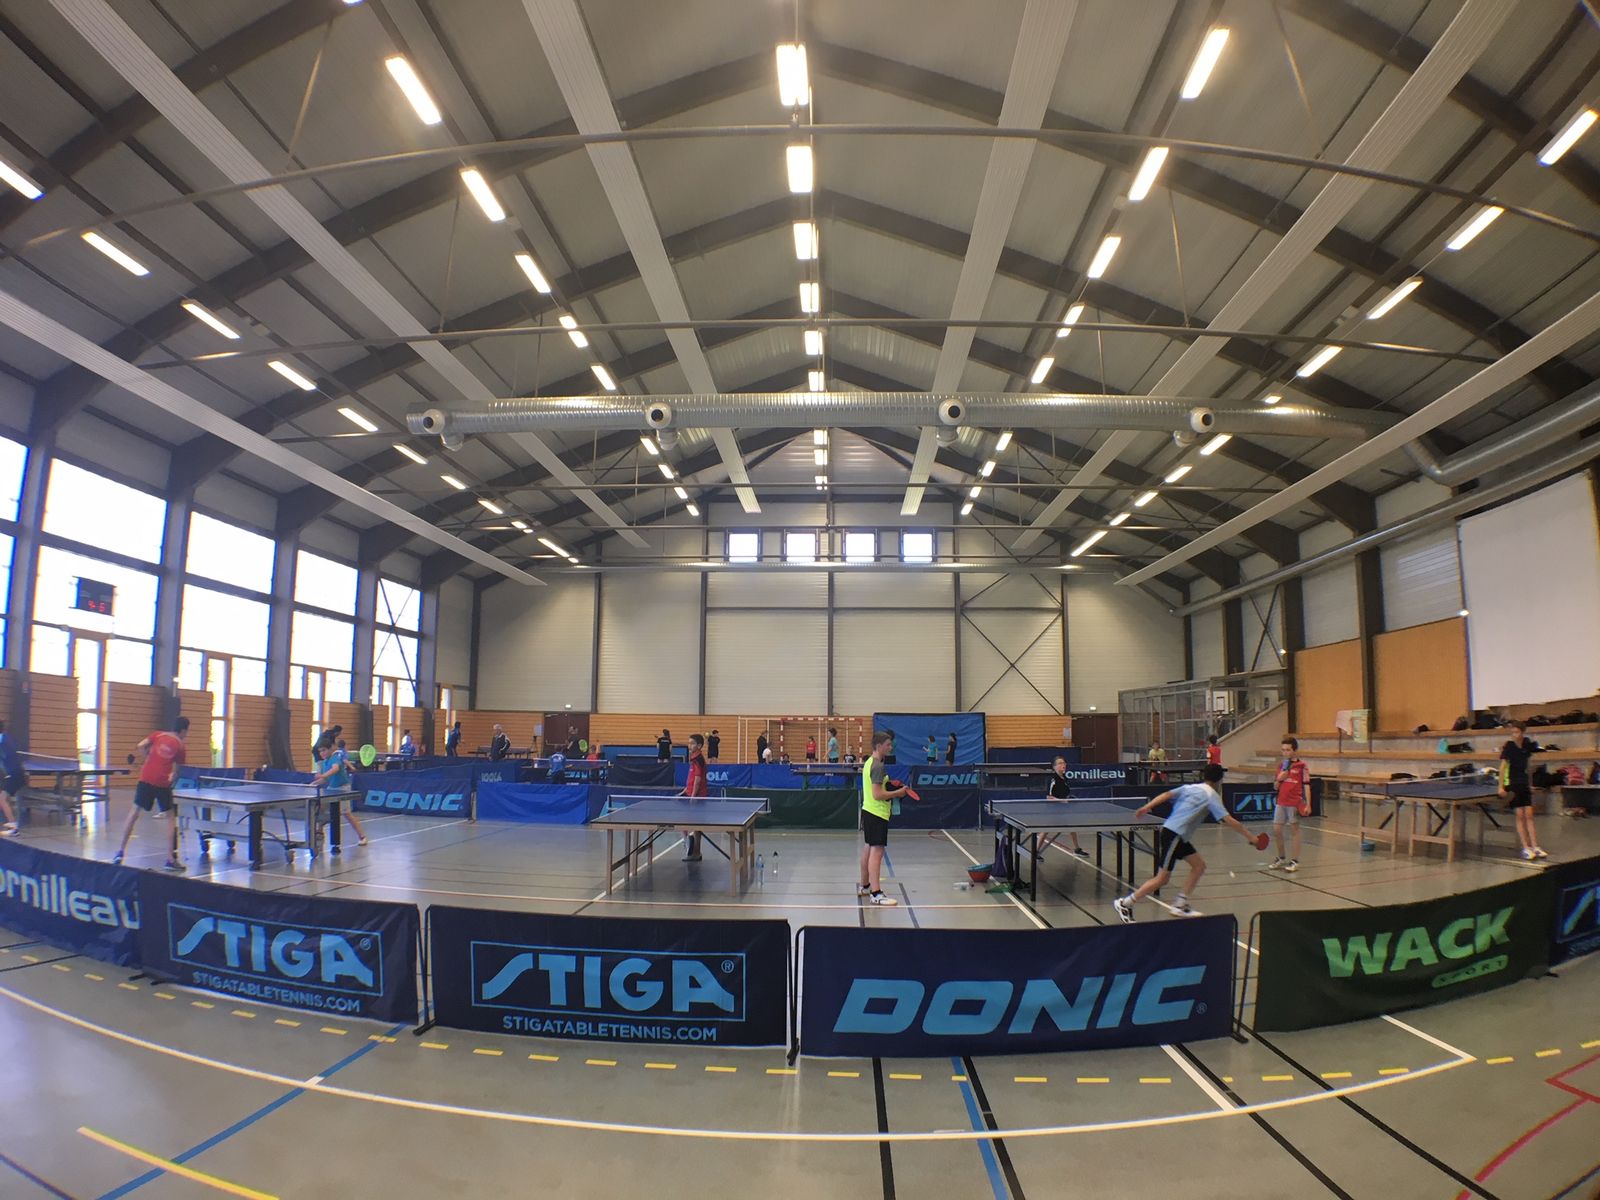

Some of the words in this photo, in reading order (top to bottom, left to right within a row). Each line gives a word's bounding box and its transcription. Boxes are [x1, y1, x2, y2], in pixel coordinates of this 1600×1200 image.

[705, 771, 728, 782] OLA
[1065, 768, 1126, 780] ornilleau
[364, 790, 463, 811] DONIC
[1236, 794, 1276, 811] STI
[178, 917, 373, 987] STIGA
[1321, 906, 1515, 977] WACK
[192, 971, 360, 1013] STIGATABLETENNIS.COM
[482, 952, 734, 1013] STIGA
[833, 965, 1207, 1035] DONIC
[502, 1015, 717, 1042] STIGATABLETENNIS.COM
